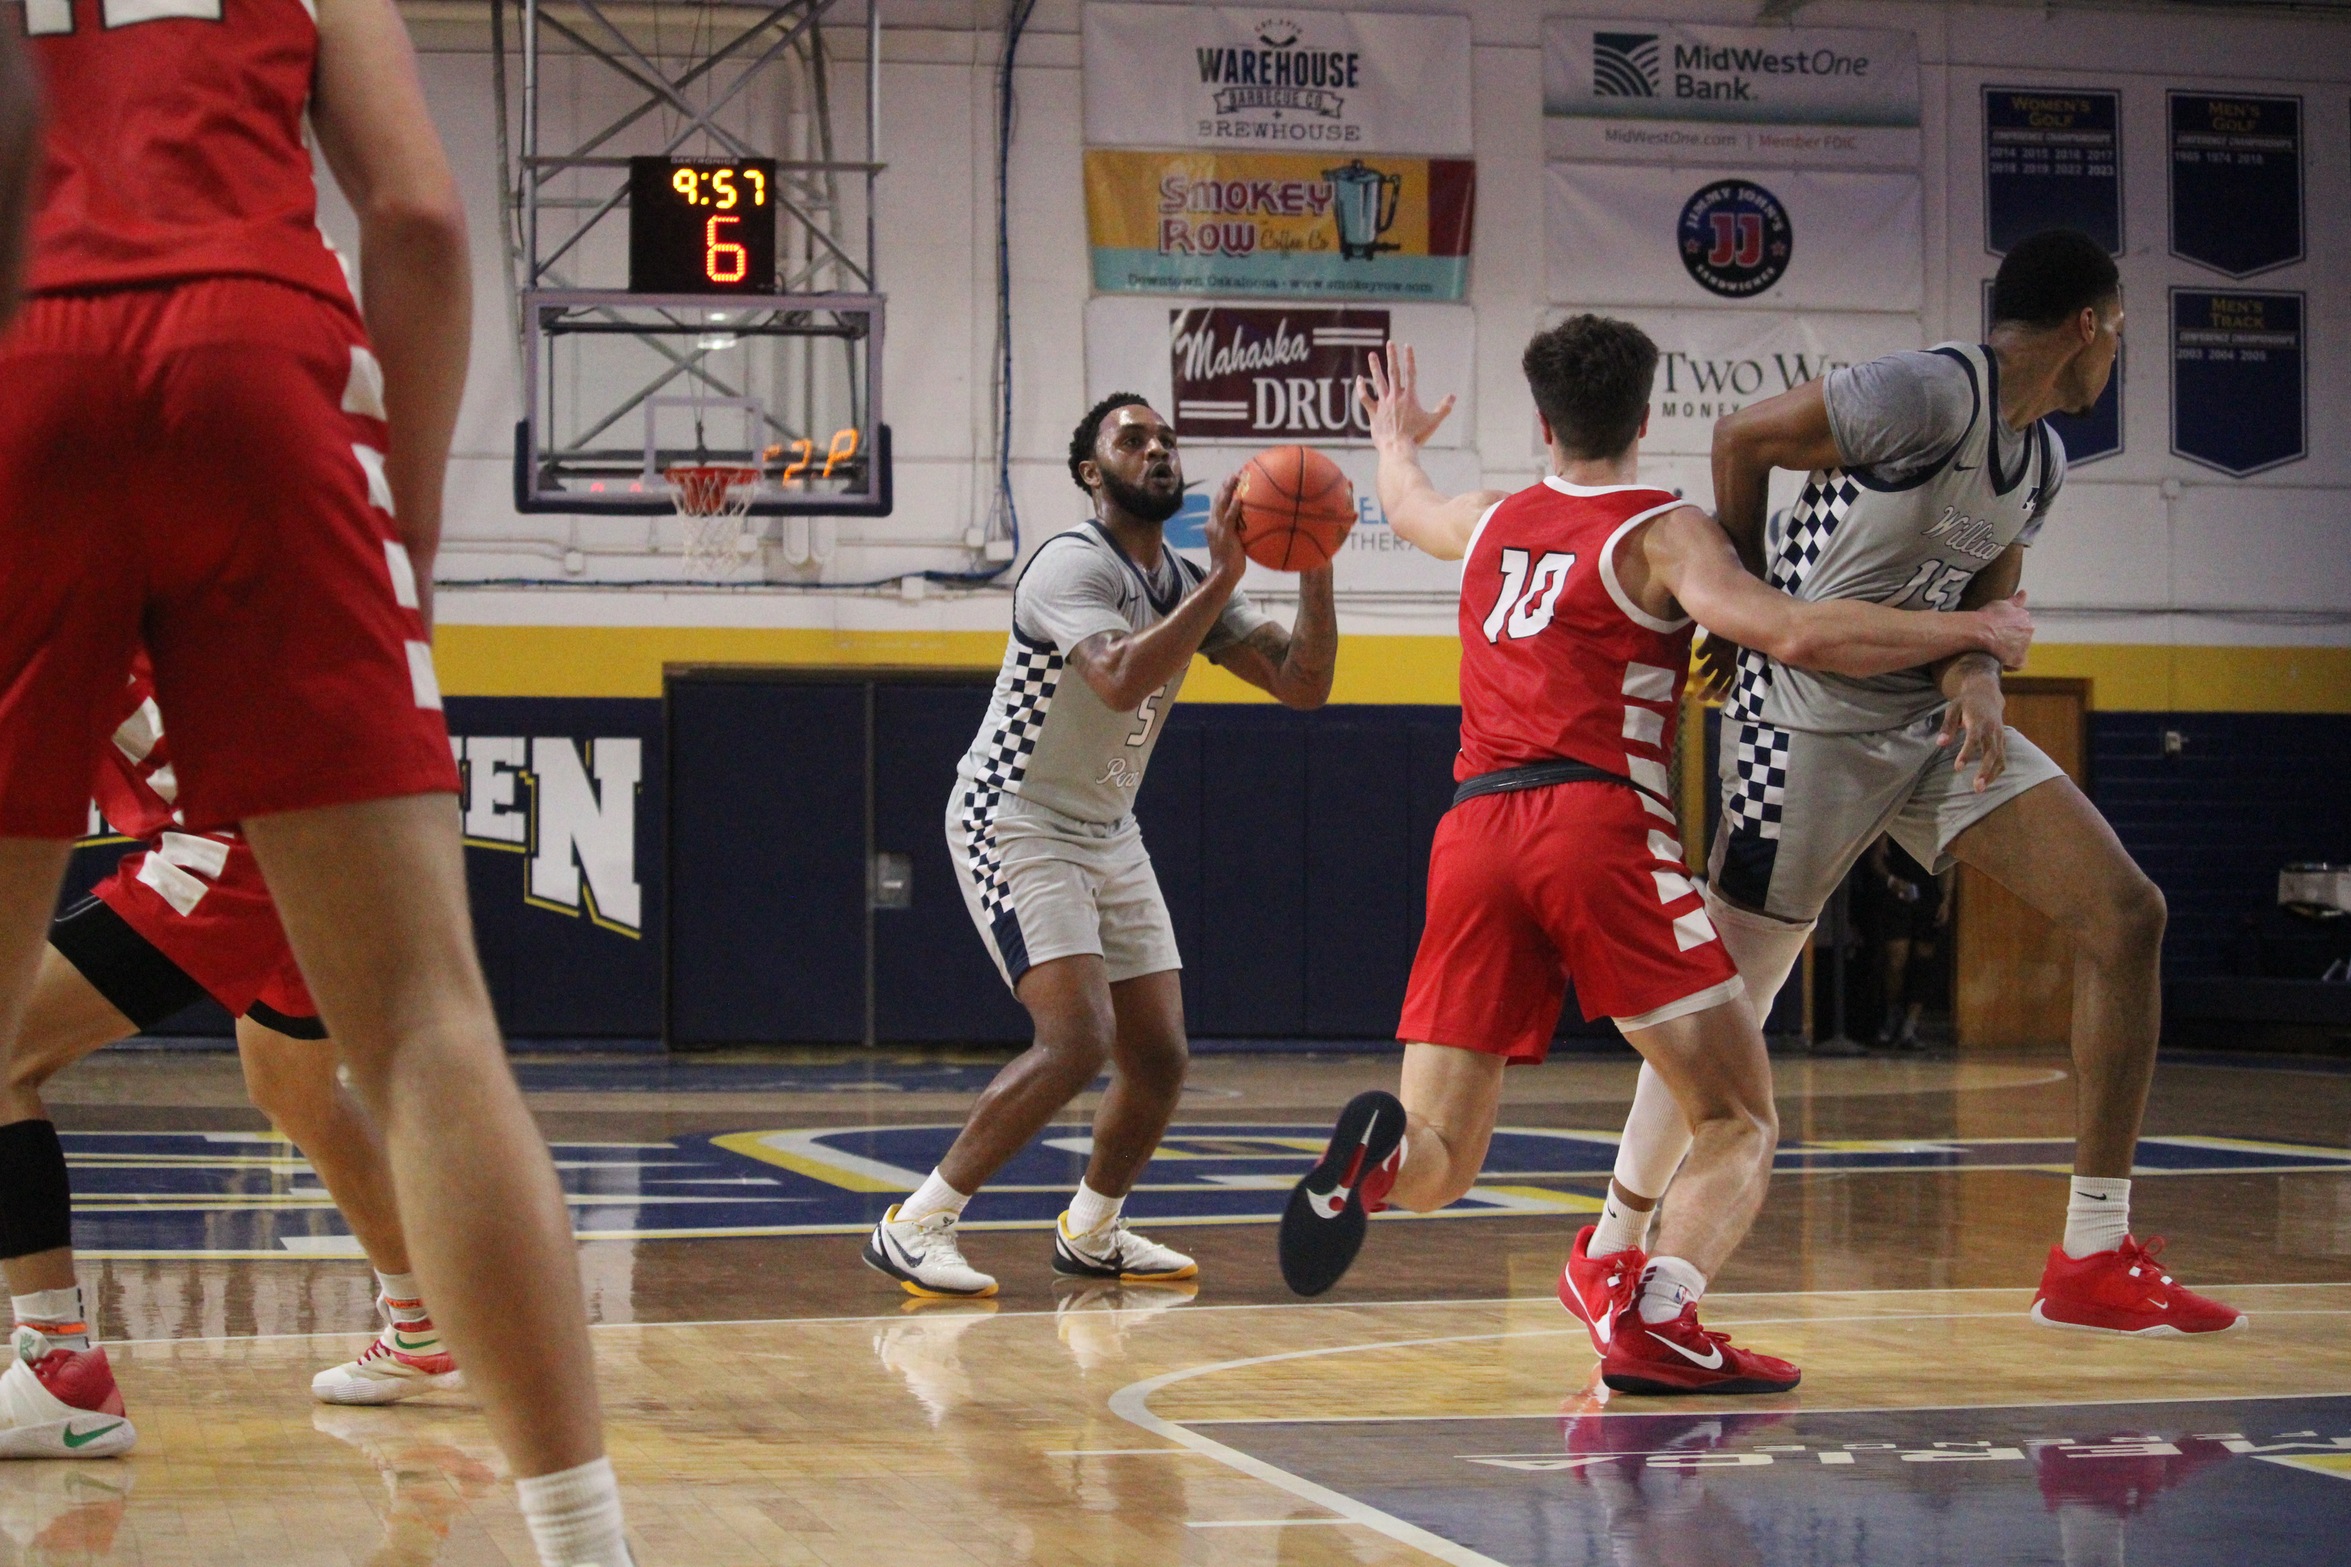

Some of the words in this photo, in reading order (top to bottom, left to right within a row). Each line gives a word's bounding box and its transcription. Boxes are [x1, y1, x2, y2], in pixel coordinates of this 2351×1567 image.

[1196, 47, 1359, 88] WAREHOUSE
[1673, 44, 1870, 77] MidWestOne
[1199, 120, 1361, 142] BREWHOUSE
[673, 168, 764, 209] 9:57
[1160, 175, 1335, 216] SMOKEY
[707, 214, 746, 282] 6
[1160, 217, 1256, 256] ROW
[1708, 212, 1763, 268] JJ
[1175, 317, 1309, 381] Mahaska
[1350, 532, 1413, 552] THER
[1482, 546, 1576, 644] 10
[1125, 683, 1167, 748] 5
[448, 736, 641, 930] EN
